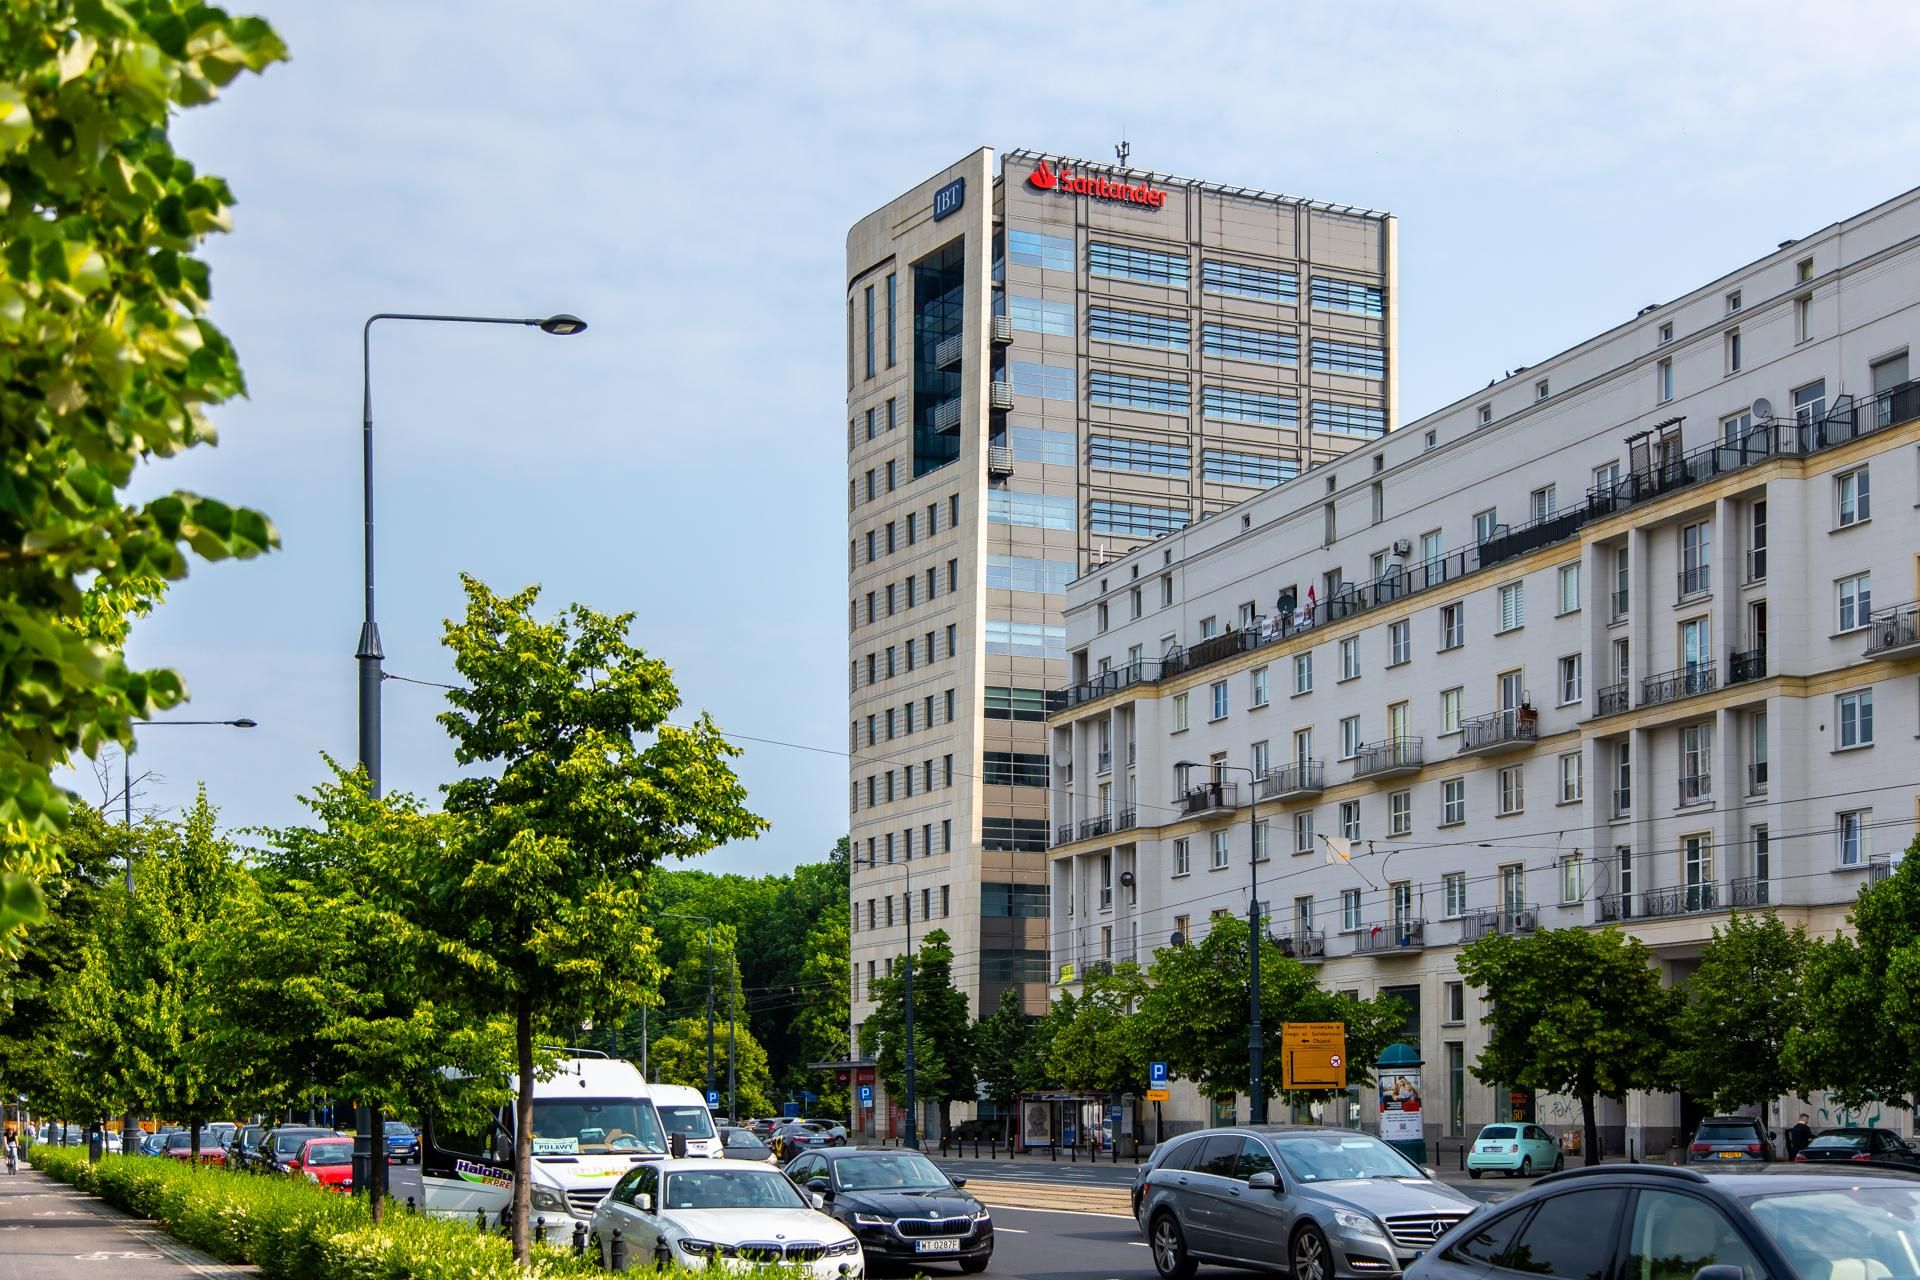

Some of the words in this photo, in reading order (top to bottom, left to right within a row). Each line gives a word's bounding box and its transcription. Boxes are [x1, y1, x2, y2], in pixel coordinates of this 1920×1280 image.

[1060, 170, 1168, 207] Santander
[937, 185, 958, 213] IBT
[1154, 1064, 1163, 1079] P
[709, 1092, 717, 1102] P
[862, 1088, 870, 1099] P
[921, 1241, 931, 1250] WT
[933, 1240, 957, 1250] 0287F
